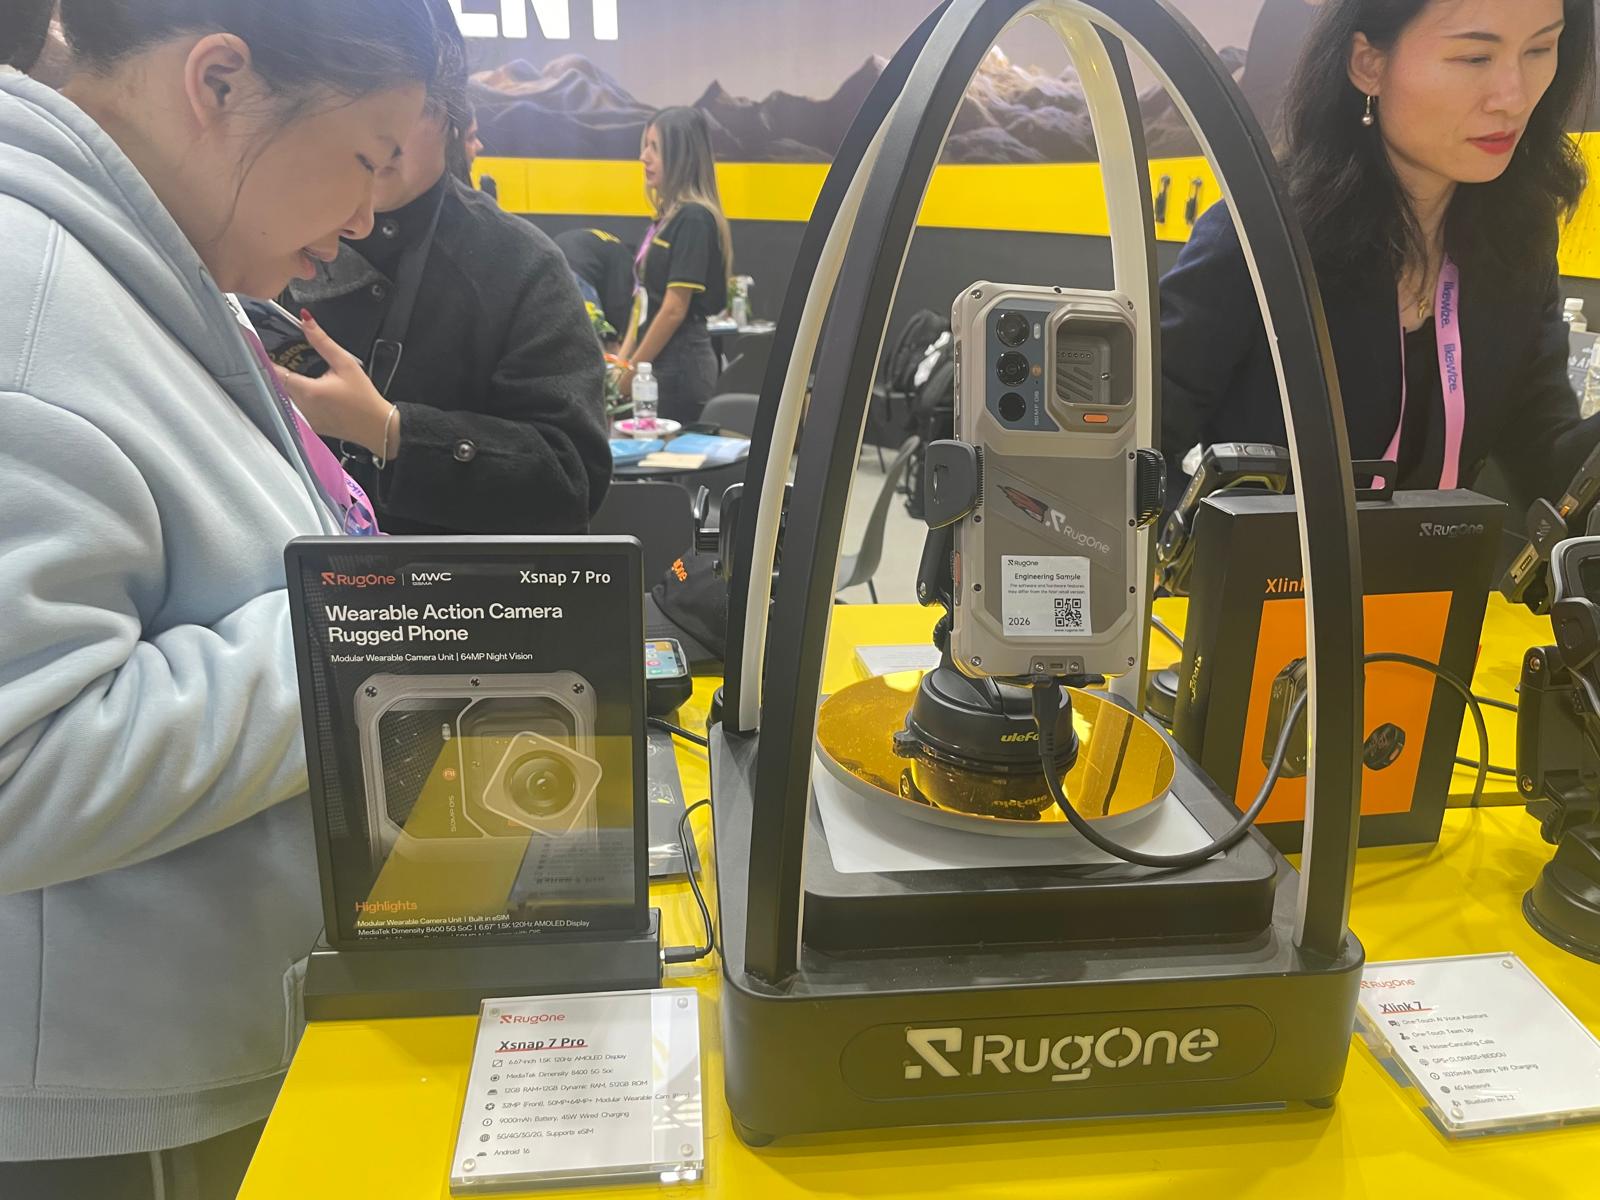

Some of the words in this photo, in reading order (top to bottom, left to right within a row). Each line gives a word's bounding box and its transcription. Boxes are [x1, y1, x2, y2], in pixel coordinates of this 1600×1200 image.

[1063, 525, 1111, 553] RugOne
[337, 574, 396, 587] RugOne
[411, 572, 452, 582] MWC
[520, 571, 567, 587] Xsnap
[571, 571, 581, 583] 7
[586, 571, 611, 584] Pro
[1014, 573, 1054, 581] Engineering
[1056, 573, 1081, 581] Sample
[325, 604, 419, 622] Wearable
[423, 603, 484, 620] Action
[489, 603, 563, 619] Camera
[1008, 617, 1031, 626] 2026
[328, 627, 403, 645] Rugged
[408, 626, 469, 642] Phone
[331, 654, 364, 663] Modular
[365, 653, 403, 663] Wearable
[405, 653, 437, 662] Camera
[438, 653, 454, 661] Unit
[461, 653, 485, 661] 64MP
[486, 652, 509, 662] Night
[510, 652, 533, 660] Vision
[1000, 731, 1039, 742] ulefo
[355, 901, 418, 914] Highlights
[358, 928, 390, 936] MediaTek
[391, 927, 424, 935] Dimensity
[566, 919, 590, 928] Display
[386, 918, 419, 926] Wearable
[420, 917, 447, 925] Camera
[1369, 979, 1416, 989] RugOne
[1378, 1002, 1415, 1014] Xlink
[1413, 1001, 1422, 1010] 7
[513, 1014, 566, 1024] RugOne
[499, 1040, 544, 1050] Xsnap
[548, 1038, 557, 1047] 7
[561, 1037, 585, 1047] Pro
[971, 1027, 1219, 1082] RugOne
[499, 1116, 532, 1124] 9000mAh
[601, 1111, 629, 1119] Charging
[494, 1148, 520, 1156] Android
